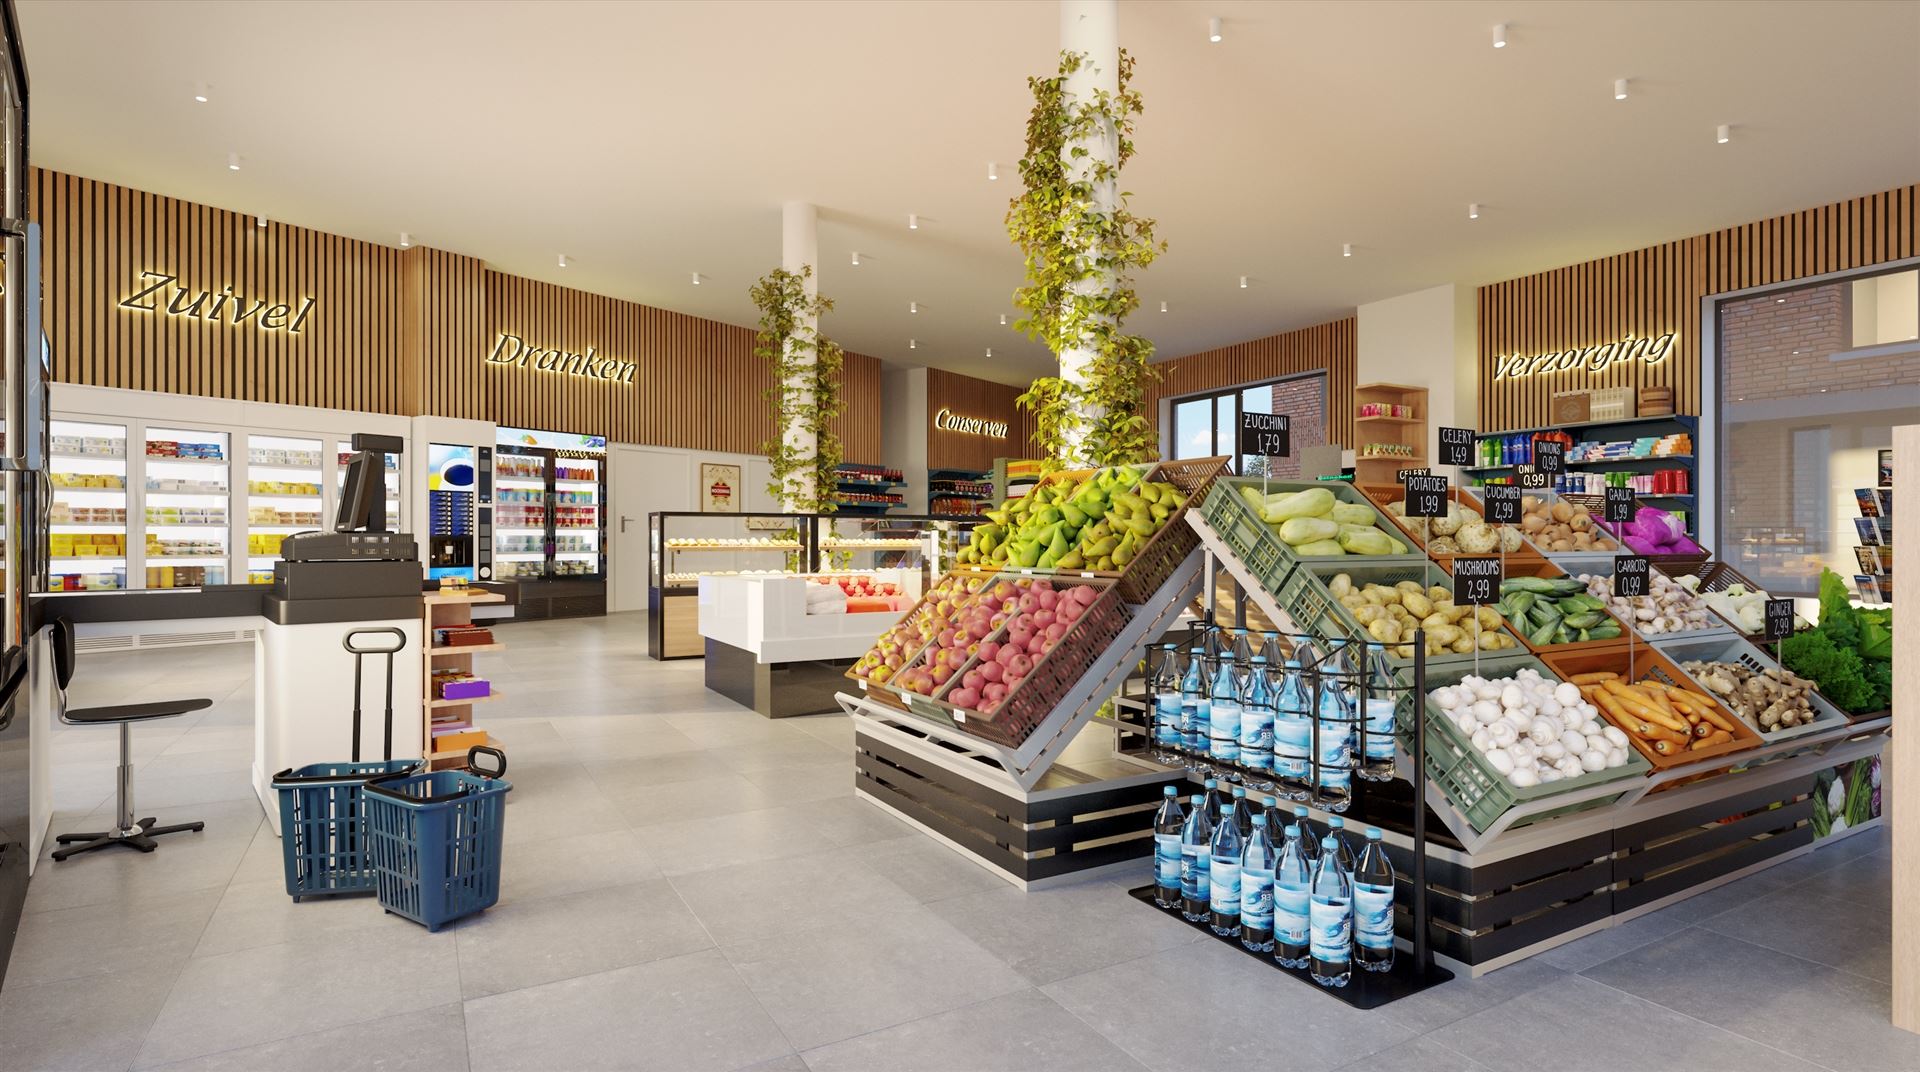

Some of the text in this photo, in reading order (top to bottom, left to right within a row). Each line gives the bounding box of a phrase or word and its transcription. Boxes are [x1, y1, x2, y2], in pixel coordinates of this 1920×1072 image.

[119, 271, 316, 334] Zuivel
[487, 333, 639, 384] Dranken
[1494, 332, 1677, 380] Verzorging
[936, 408, 1009, 438] Conserven
[1244, 413, 1287, 431] ZUCCHINI
[1257, 433, 1280, 454] 1,79
[1442, 429, 1473, 445] CELERY
[1450, 446, 1467, 463] 1,49
[1538, 441, 1561, 455] ONIONS
[1542, 455, 1558, 471] 0,99
[1408, 476, 1446, 493] POTATOES
[1523, 473, 1545, 487] 0,99
[1485, 485, 1521, 499] CUCUMBER
[1608, 488, 1632, 501] GARLIC
[1419, 495, 1438, 513] 1,99
[1495, 502, 1513, 520] 2,99
[1613, 504, 1628, 521] 1,99
[1454, 559, 1499, 576] MUSHROOMS
[1616, 558, 1646, 573] CARROTS
[1467, 578, 1489, 603] 2,99
[1621, 576, 1641, 596] 0,99
[1768, 601, 1792, 617] GINGER
[1774, 617, 1790, 636] 2,99
